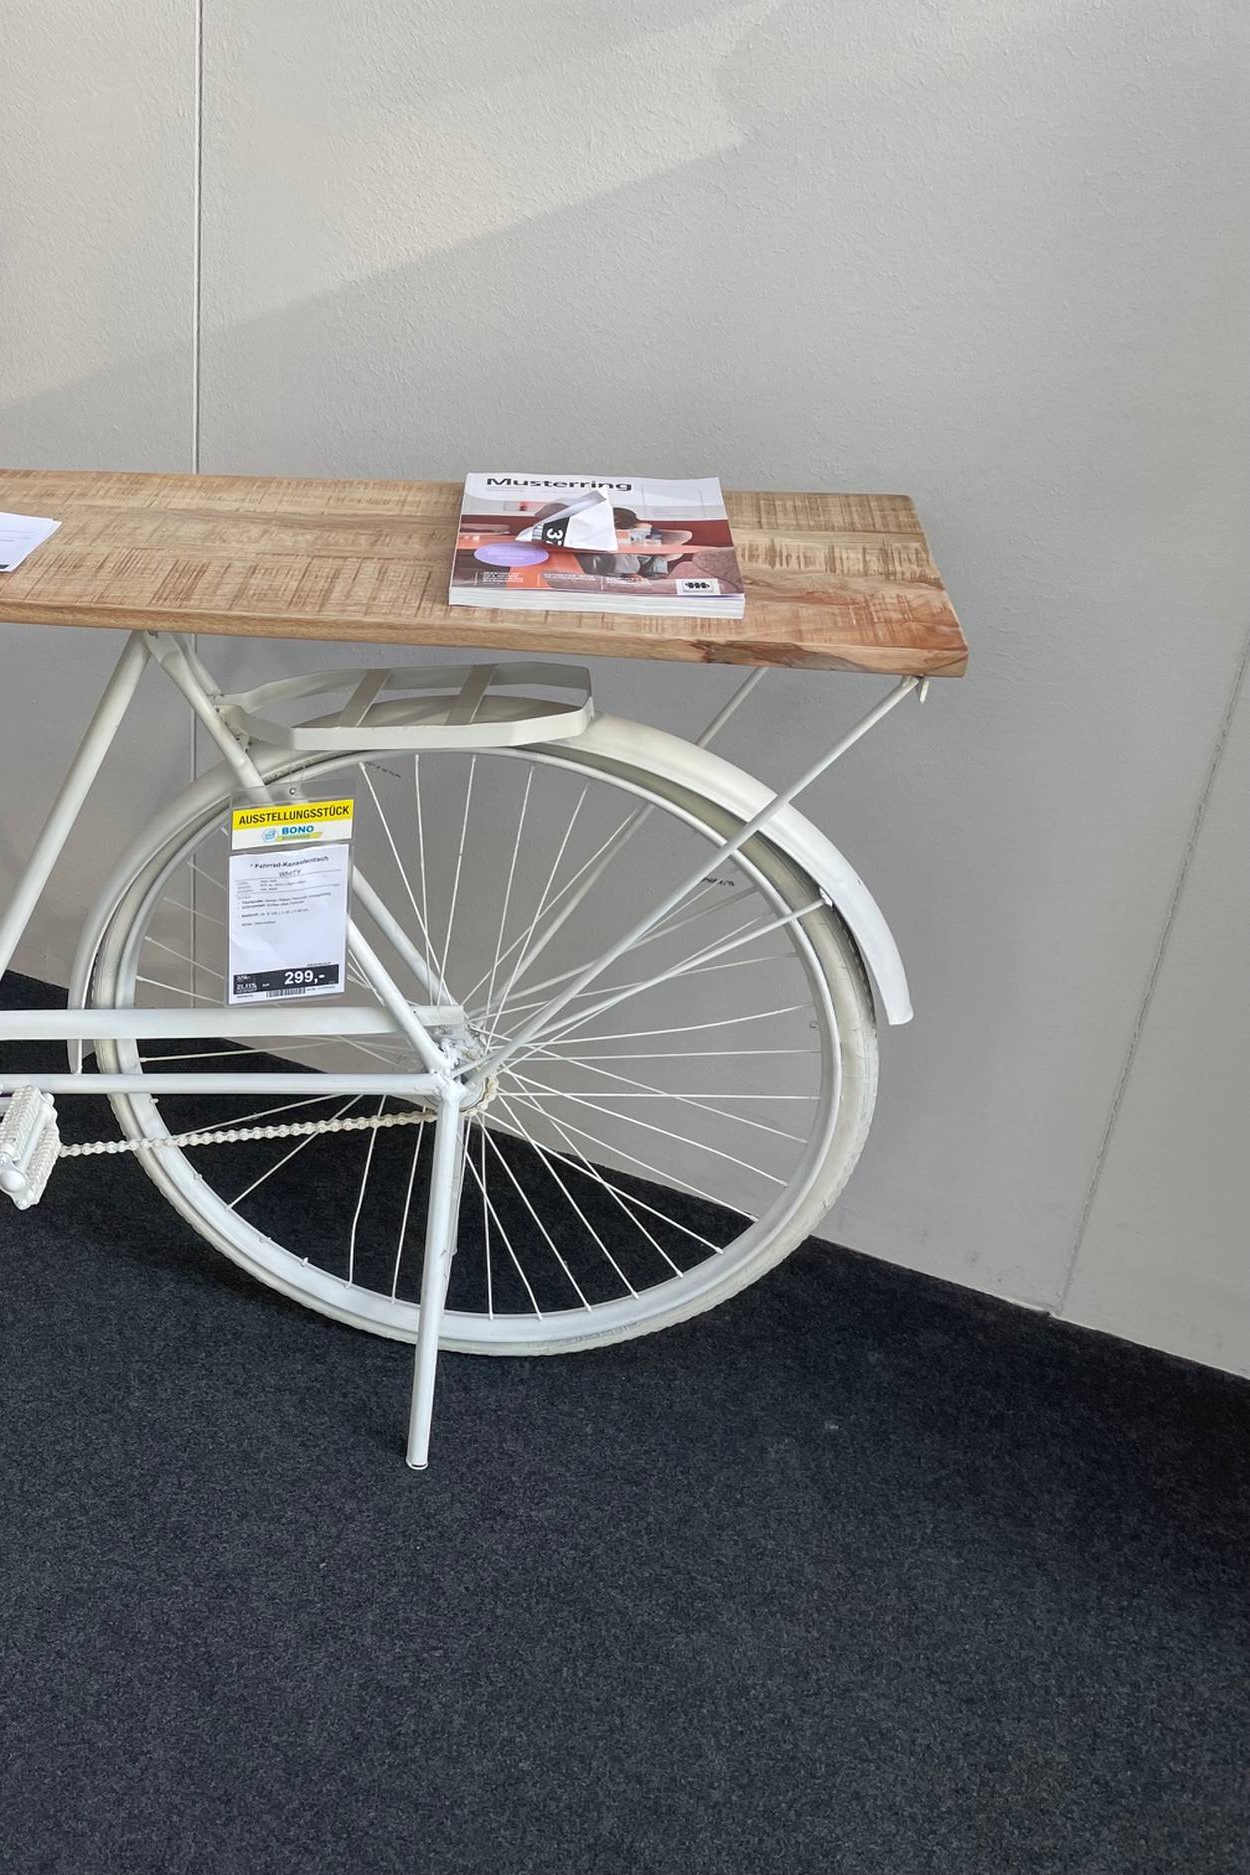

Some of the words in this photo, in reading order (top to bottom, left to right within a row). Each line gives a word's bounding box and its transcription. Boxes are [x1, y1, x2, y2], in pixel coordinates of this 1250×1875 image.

[486, 478, 632, 491] Musterring
[239, 805, 350, 825] AUSSTELLUNGSSTÜCK
[281, 825, 315, 835] BONO
[284, 970, 326, 985] 299,-
